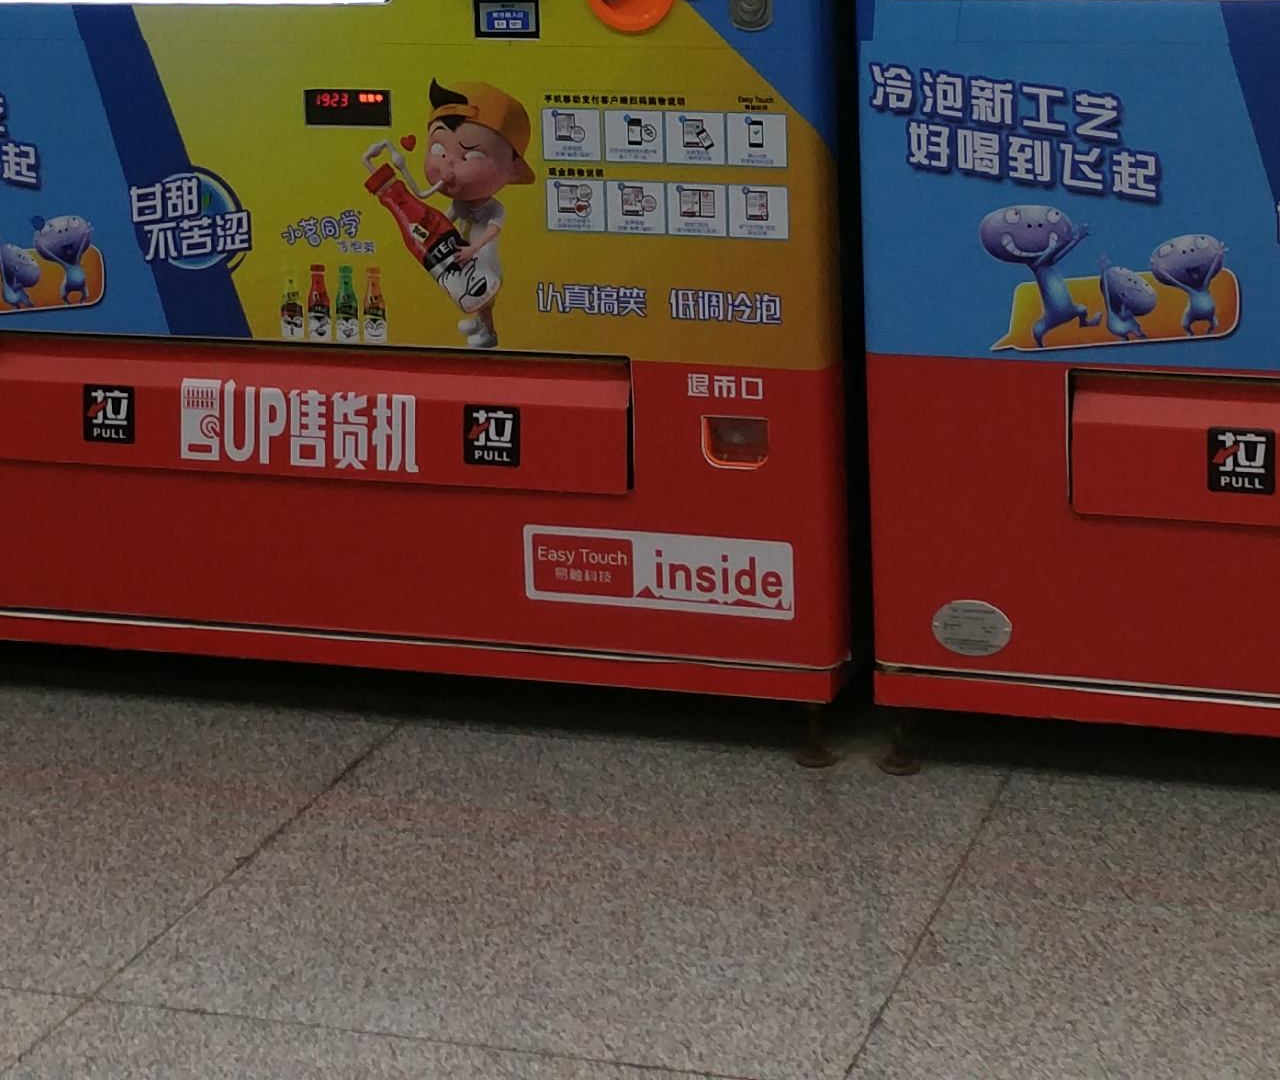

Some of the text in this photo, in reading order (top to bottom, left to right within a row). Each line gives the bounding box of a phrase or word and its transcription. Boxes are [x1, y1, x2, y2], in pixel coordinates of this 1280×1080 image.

[316, 93, 349, 108] 1923
[871, 63, 1120, 142] 冷泡新工艺
[907, 120, 1160, 200] 好喝到飞起
[129, 176, 200, 223] 甘甜
[144, 213, 251, 263] 不苦涩
[281, 209, 361, 247] 小茗同学
[537, 281, 783, 325] 认真搞笑 低调冷泡
[87, 387, 130, 427] 拉
[686, 372, 764, 402] 退币口
[93, 427, 127, 440] PULL
[223, 378, 419, 474] UP售货机
[470, 406, 514, 447] 拉
[474, 449, 512, 463] PULL
[1213, 430, 1267, 476] 拉
[1220, 476, 1266, 491] PULL
[537, 545, 629, 567] Easy Touch
[654, 549, 784, 600] inside
